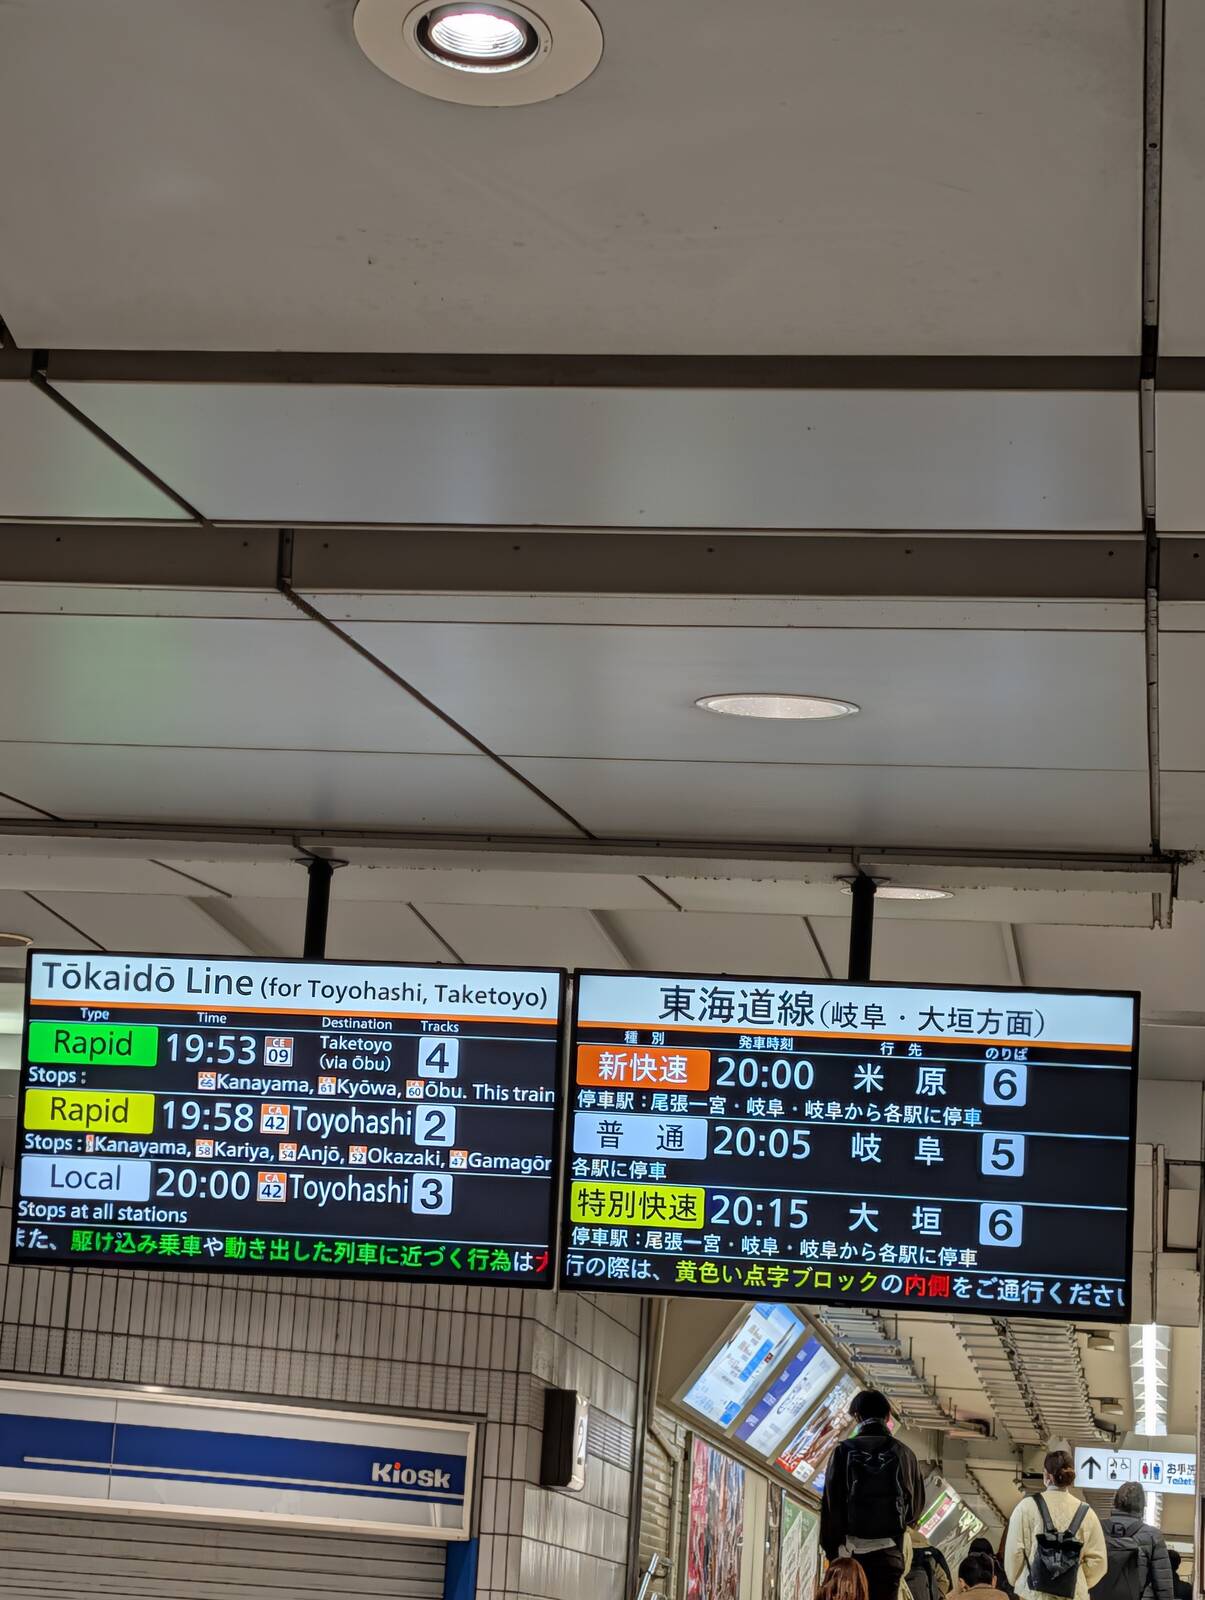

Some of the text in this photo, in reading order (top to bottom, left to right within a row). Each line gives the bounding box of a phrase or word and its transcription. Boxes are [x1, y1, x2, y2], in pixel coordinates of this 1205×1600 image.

[42, 962, 547, 1009] Tōkaidō Line (for Toyohashi, Taketoyo)
[81, 1008, 109, 1020] Type
[197, 1012, 227, 1023] Time
[322, 1017, 393, 1031] Destination
[421, 1021, 459, 1033] Tracks
[54, 1030, 133, 1060] Rapid
[167, 1032, 256, 1065] 19:53
[268, 1049, 289, 1063] 09
[321, 1036, 393, 1052] Taketoyo
[425, 1043, 449, 1073] 4
[739, 1036, 793, 1050] 発車時刻
[985, 1048, 1028, 1061] のりば
[320, 1055, 391, 1072] (via Ōbu)
[598, 1052, 688, 1084] 新快速
[716, 1057, 814, 1090] 20:00
[217, 1075, 314, 1095] Kanayama,
[338, 1079, 402, 1099] Kyōwa,
[409, 1087, 422, 1097] 60
[425, 1081, 467, 1099] Ōbu.
[474, 1084, 509, 1101] This
[513, 1086, 554, 1103] train
[993, 1069, 1017, 1100] 6
[51, 1097, 129, 1128] Rapid
[163, 1101, 253, 1132] 19:58
[265, 1116, 285, 1131] 42
[294, 1106, 412, 1138] Toyohashi
[424, 1110, 447, 1141] 2
[95, 1137, 191, 1157] Kanayama,
[198, 1146, 211, 1155] 58
[215, 1142, 274, 1161] Kariya,
[281, 1149, 294, 1160] 54
[297, 1145, 345, 1165] Anjō,
[352, 1152, 364, 1162] 52
[368, 1148, 445, 1168] Okazaki,
[468, 1153, 551, 1173] Gamagōr
[714, 1126, 811, 1159] 20:05
[991, 1139, 1014, 1170] 5
[51, 1164, 120, 1190] Local
[156, 1168, 249, 1200] 20:00
[572, 1159, 666, 1180] 各駅に停車
[261, 1184, 282, 1199] 42
[290, 1174, 409, 1207] Toyohashi
[420, 1179, 443, 1209] 3
[578, 1188, 697, 1222] 特別快速
[18, 1202, 187, 1223] Stops at all stations
[710, 1195, 808, 1228] 20:15
[989, 1209, 1013, 1240] 6
[371, 1461, 451, 1490] Kiosk
